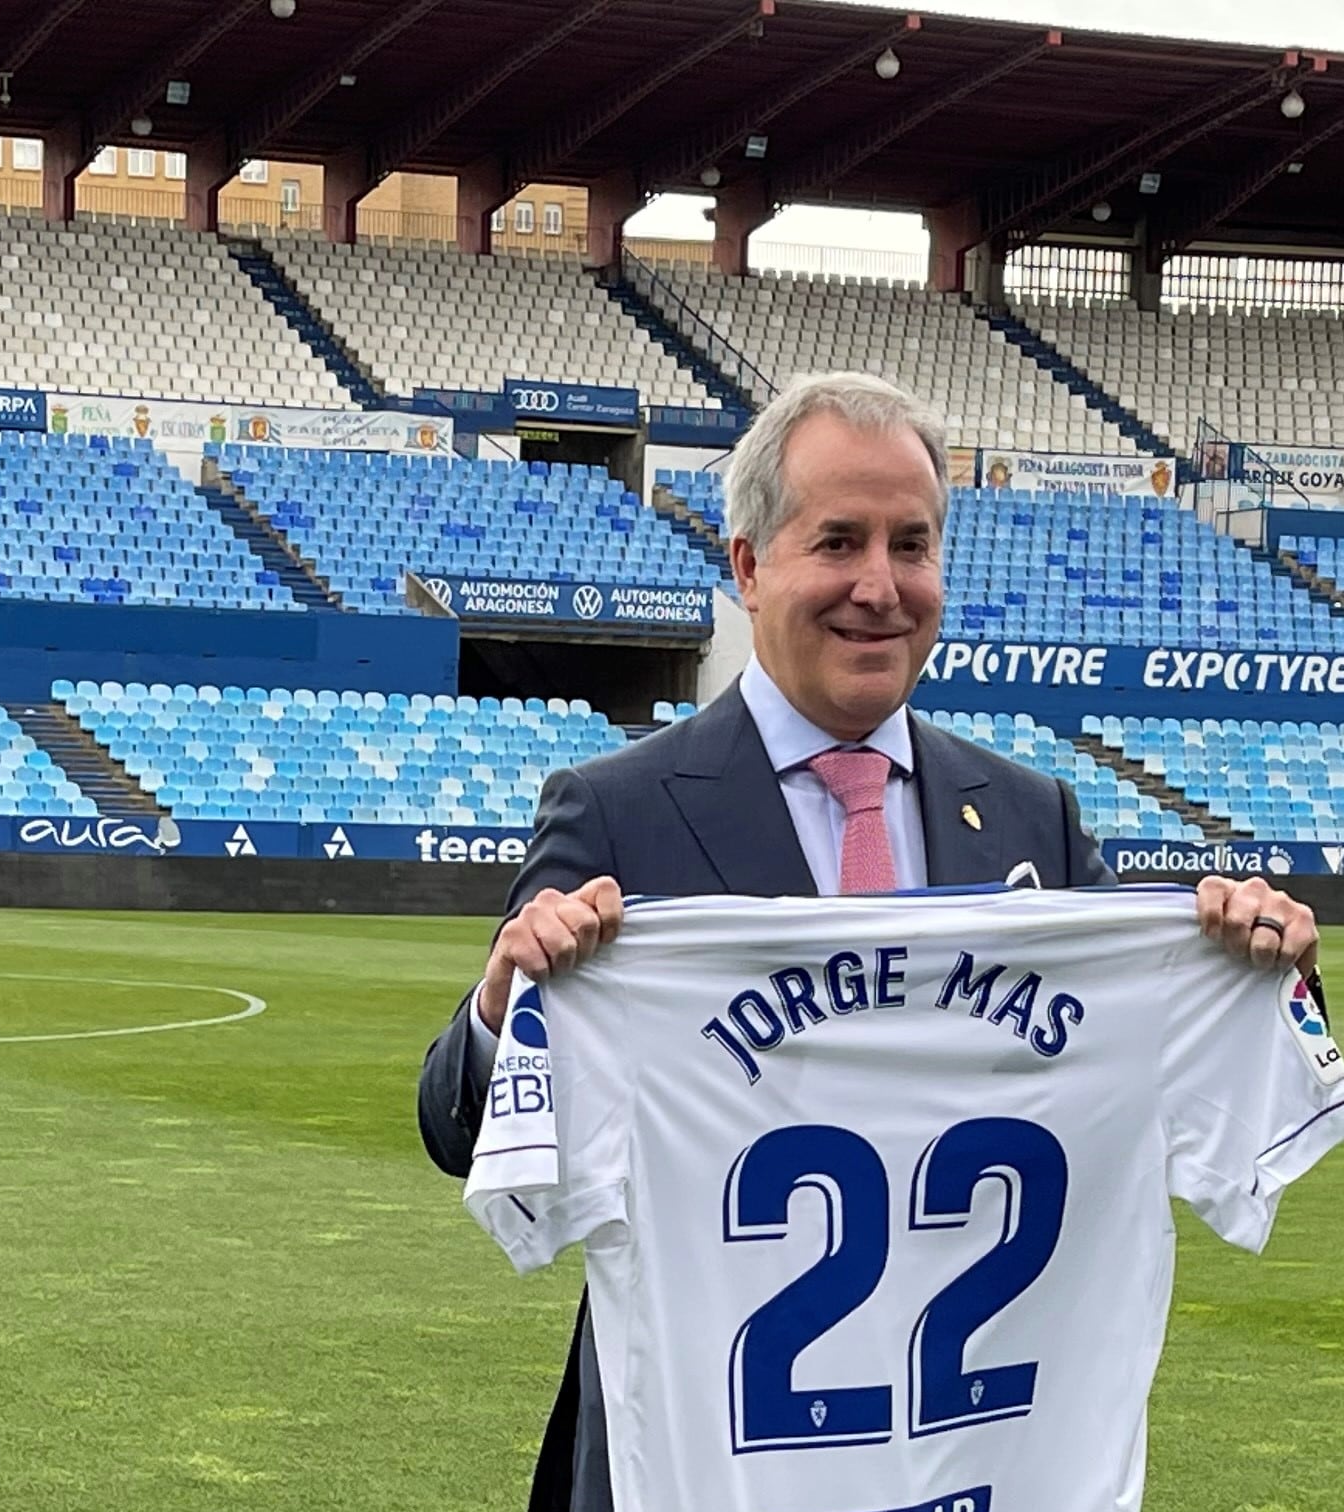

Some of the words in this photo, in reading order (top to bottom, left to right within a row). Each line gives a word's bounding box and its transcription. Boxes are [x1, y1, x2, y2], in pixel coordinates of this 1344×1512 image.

[81, 403, 112, 422] PEÑA
[459, 582, 559, 600] AUTOMOCIÓN
[610, 588, 706, 608] AUTOMOCIÓN
[465, 597, 555, 615] ARAGONESA
[614, 604, 702, 622] ARAGONESA
[919, 642, 1108, 686] XPOTYRE
[19, 818, 164, 850] aura
[415, 828, 533, 864] tece
[701, 946, 909, 1086] JORGE
[934, 950, 1085, 1058] MAS
[722, 1116, 1069, 1456] 22
